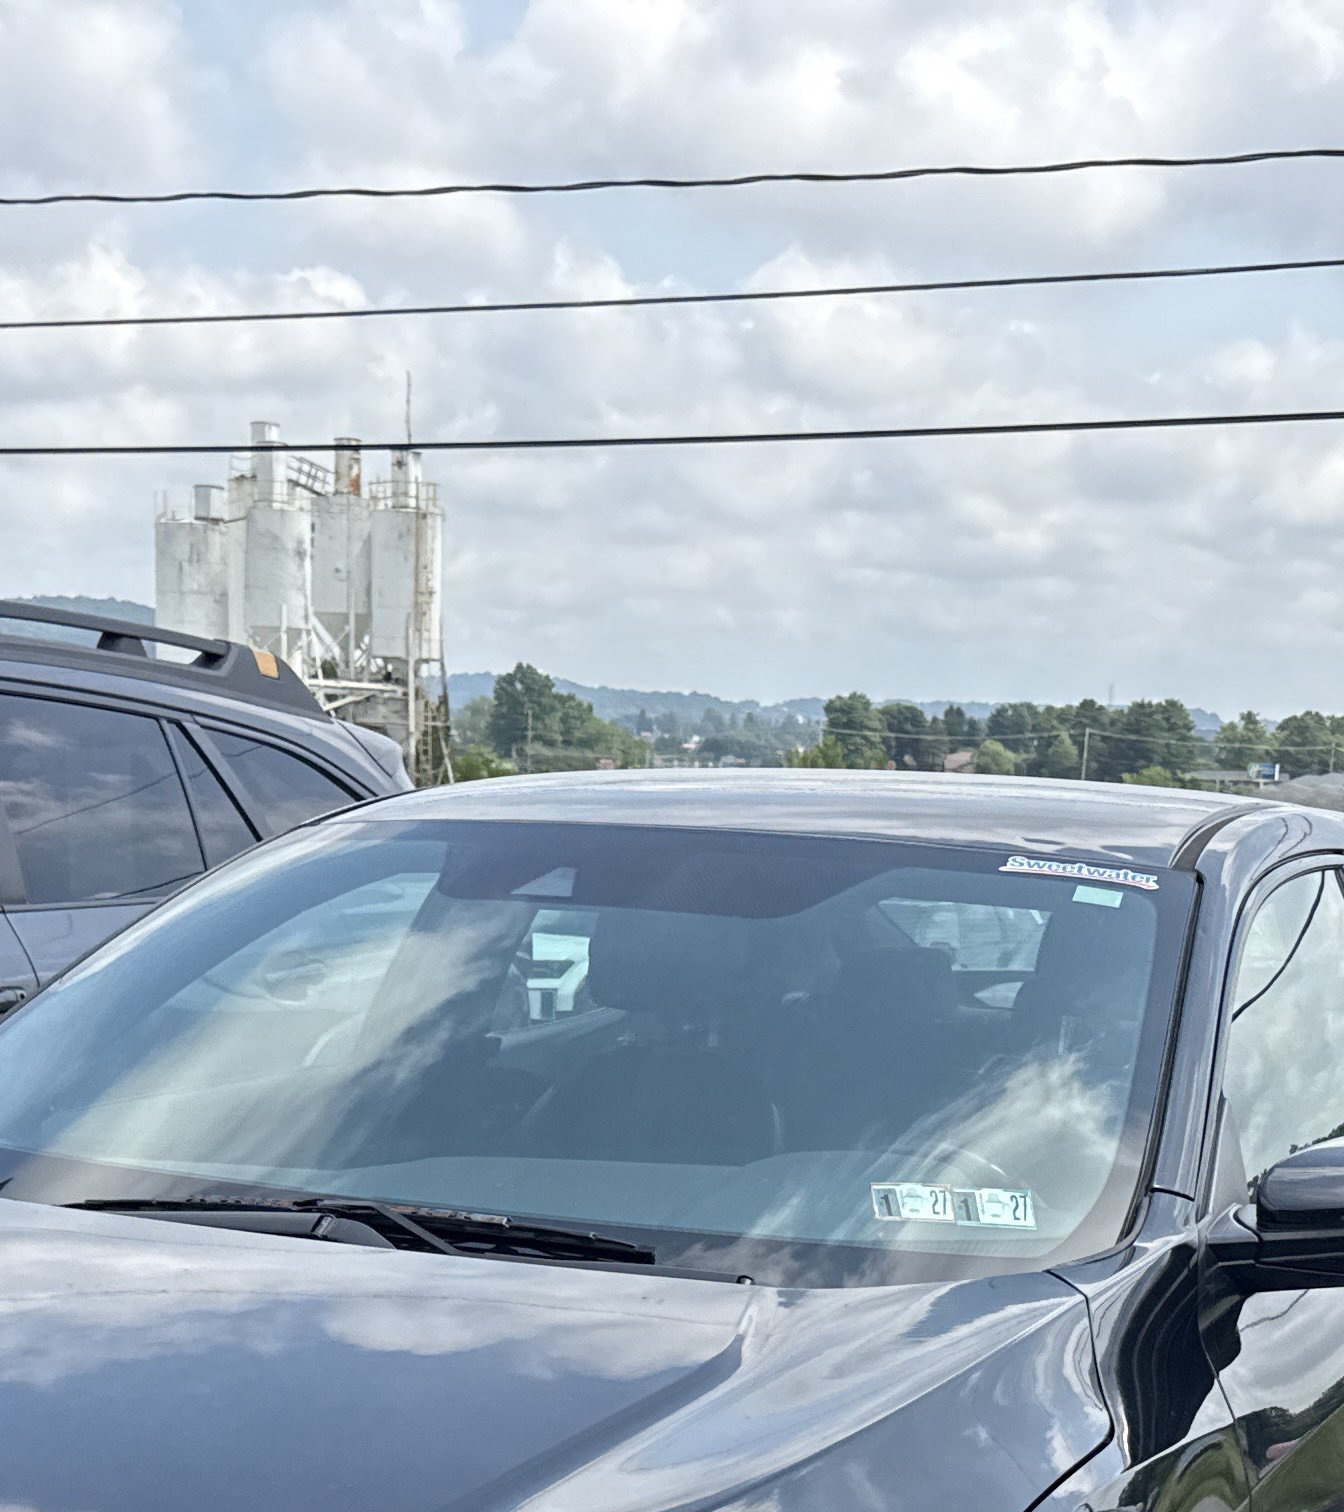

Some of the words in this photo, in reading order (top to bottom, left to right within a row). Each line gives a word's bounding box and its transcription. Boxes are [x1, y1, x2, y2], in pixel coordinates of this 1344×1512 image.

[1008, 857, 1158, 885] Sweetwater
[930, 1190, 947, 1216] 27
[1009, 1194, 1028, 1221] 27
